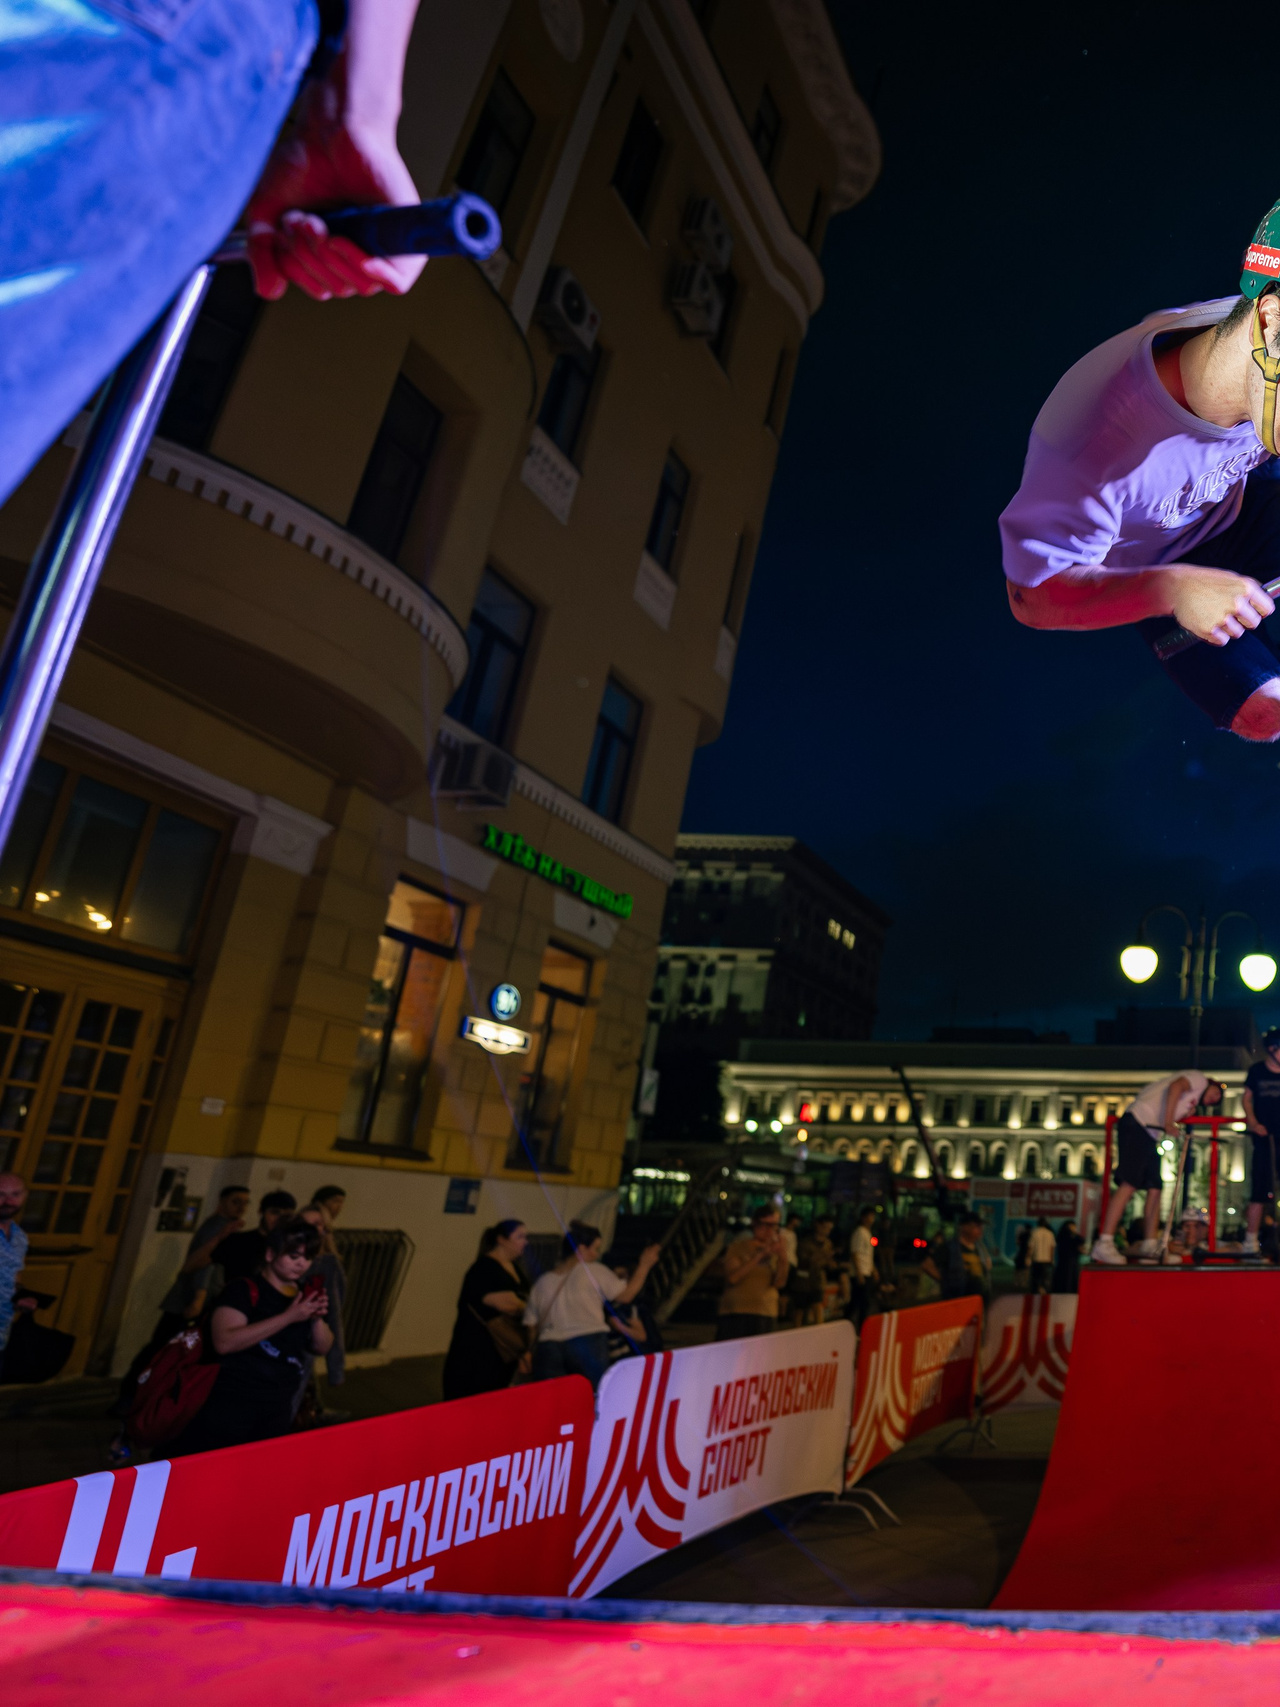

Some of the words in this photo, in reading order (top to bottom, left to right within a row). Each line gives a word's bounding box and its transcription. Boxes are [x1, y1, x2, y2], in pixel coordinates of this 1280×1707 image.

[705, 1350, 839, 1439] МОСКОВСКИЙ
[281, 1423, 575, 1590] МОСКОВСКИЙ
[697, 1426, 773, 1500] СПОРТ
